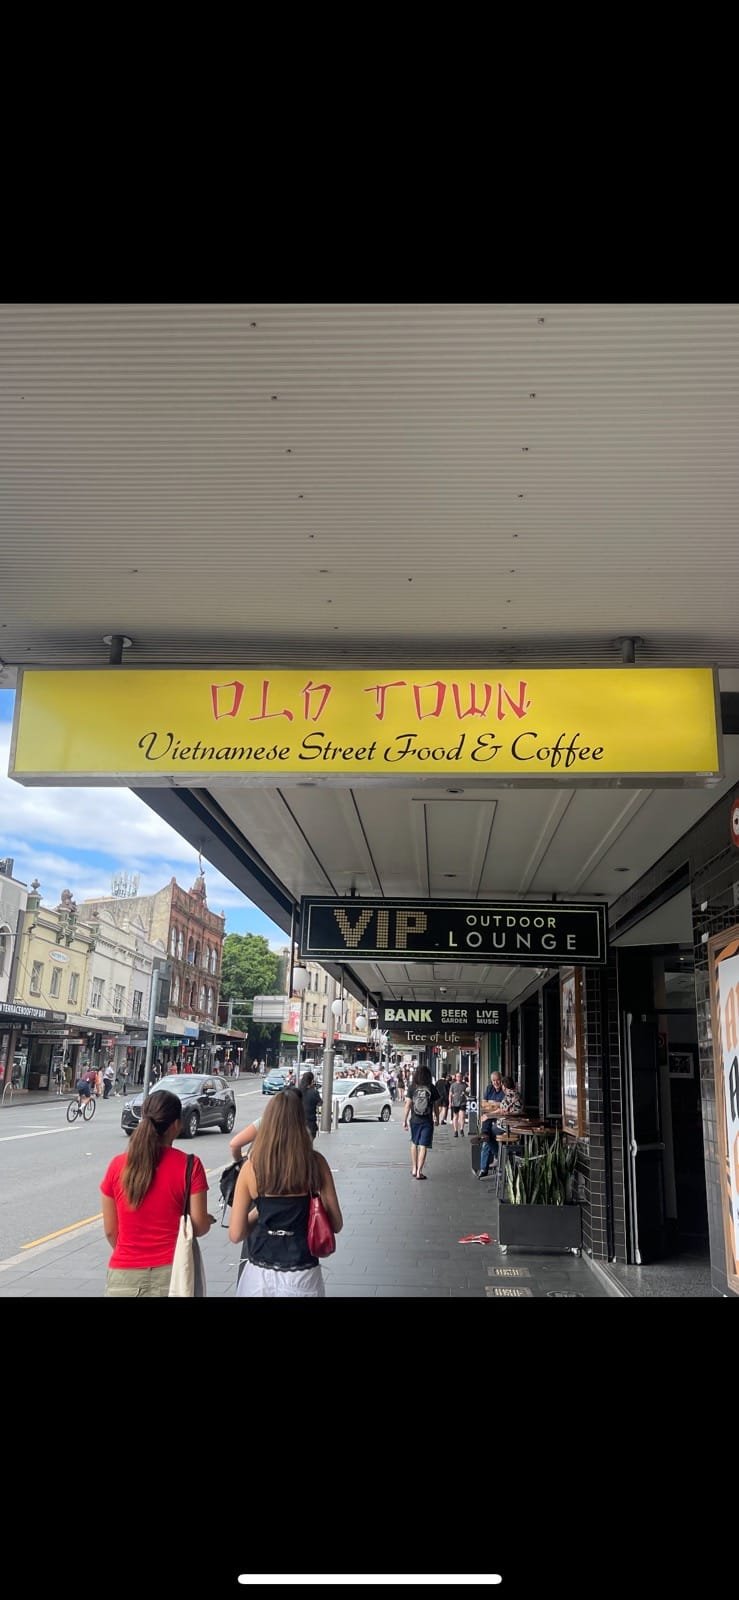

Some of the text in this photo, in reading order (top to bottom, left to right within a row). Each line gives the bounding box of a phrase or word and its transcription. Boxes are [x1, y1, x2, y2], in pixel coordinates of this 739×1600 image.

[211, 680, 532, 722] OLD TOWN
[138, 731, 605, 768] Vietnamese Street Food & Coffee
[333, 908, 428, 949] VIP
[466, 915, 557, 929] OUTDOOR
[448, 930, 578, 951] LOUNGE
[384, 1008, 433, 1024] BANK
[441, 1009, 468, 1018] BEER
[476, 1010, 499, 1019] LIVE
[405, 1031, 461, 1044] Tree of Life
